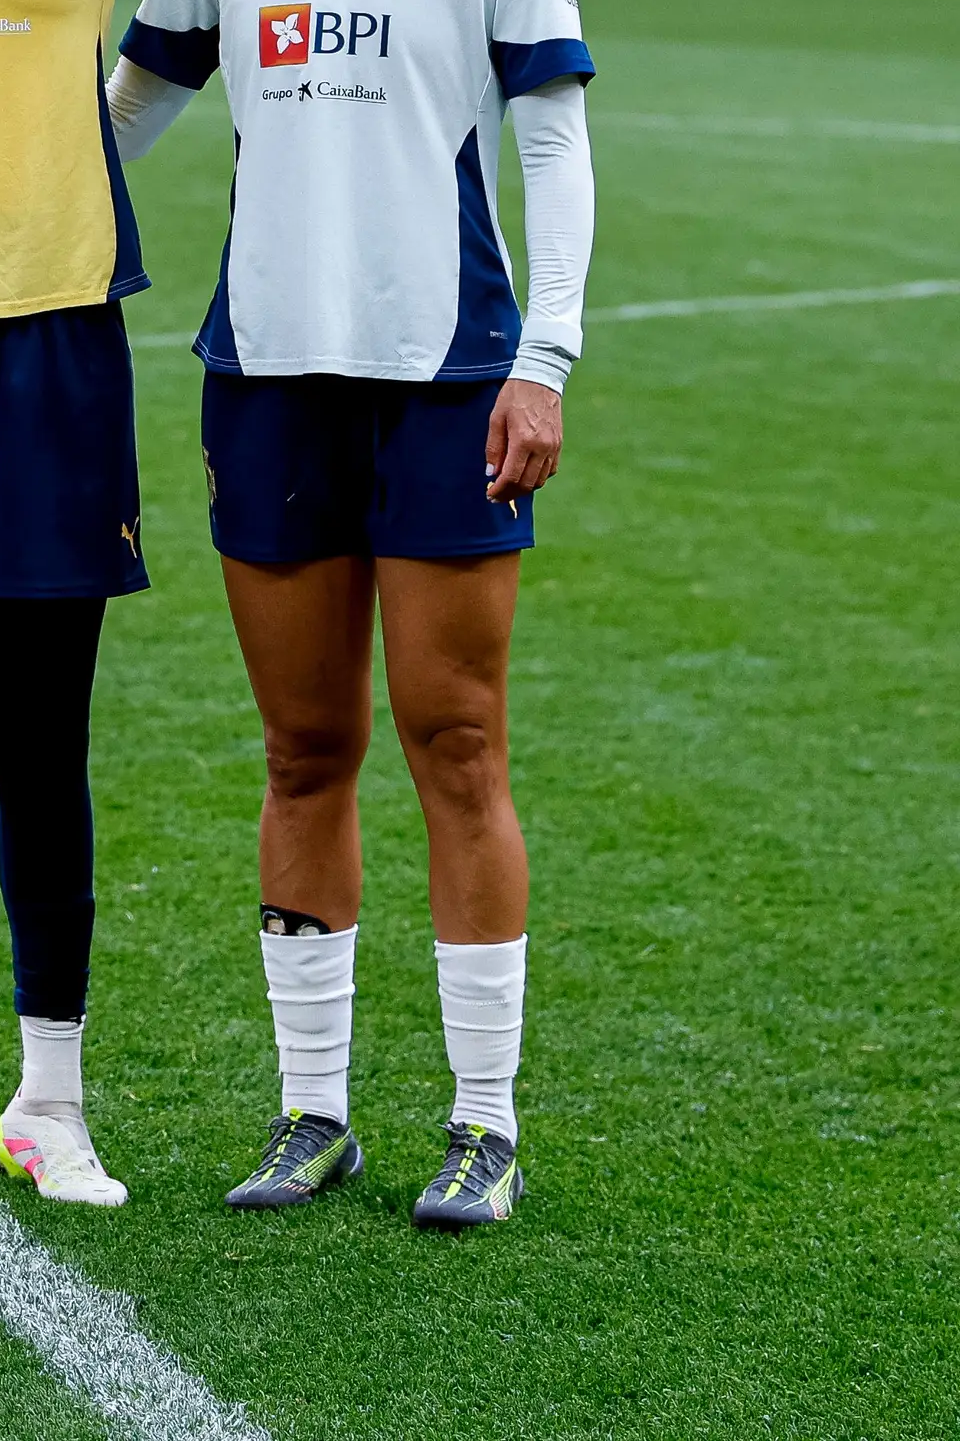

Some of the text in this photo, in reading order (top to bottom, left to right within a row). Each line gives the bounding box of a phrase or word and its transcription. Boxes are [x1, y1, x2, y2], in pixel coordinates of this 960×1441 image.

[312, 11, 392, 58] BPI
[262, 81, 387, 101] Grupo CaixaBank
